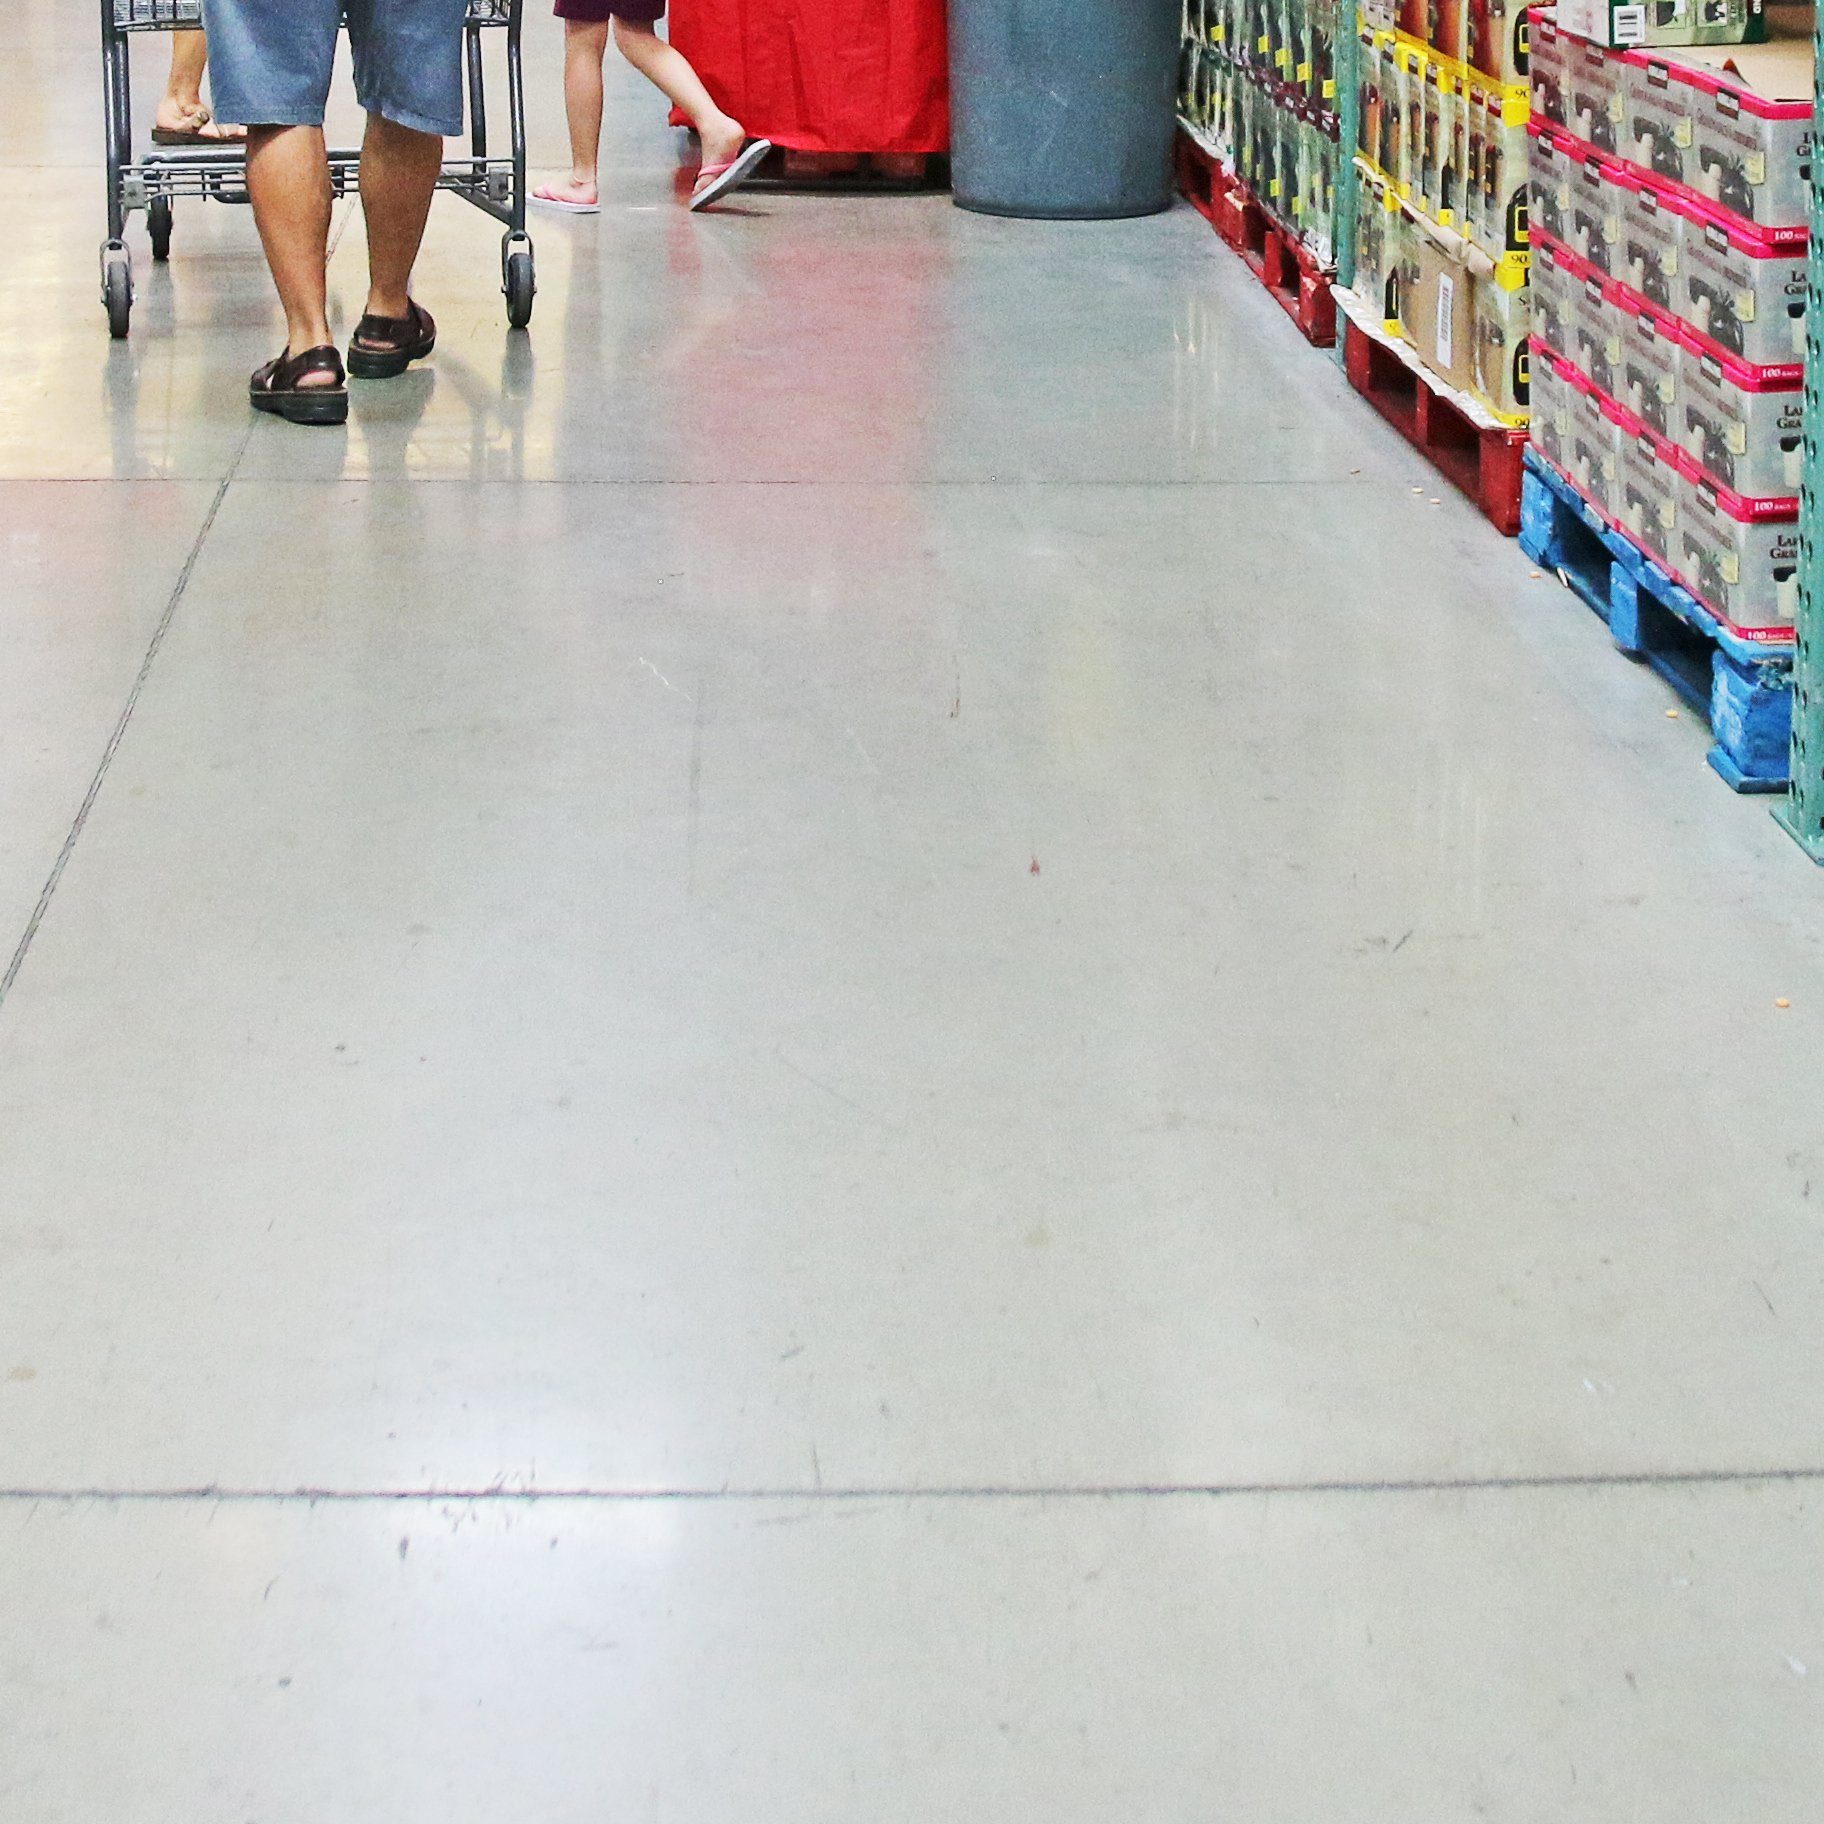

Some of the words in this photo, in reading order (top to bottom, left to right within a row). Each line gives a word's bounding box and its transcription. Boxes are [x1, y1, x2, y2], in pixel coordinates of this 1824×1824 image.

[1775, 232, 1793, 240] 100
[1762, 368, 1781, 377] 100
[1754, 501, 1773, 511] 100
[1748, 631, 1766, 640] 100
